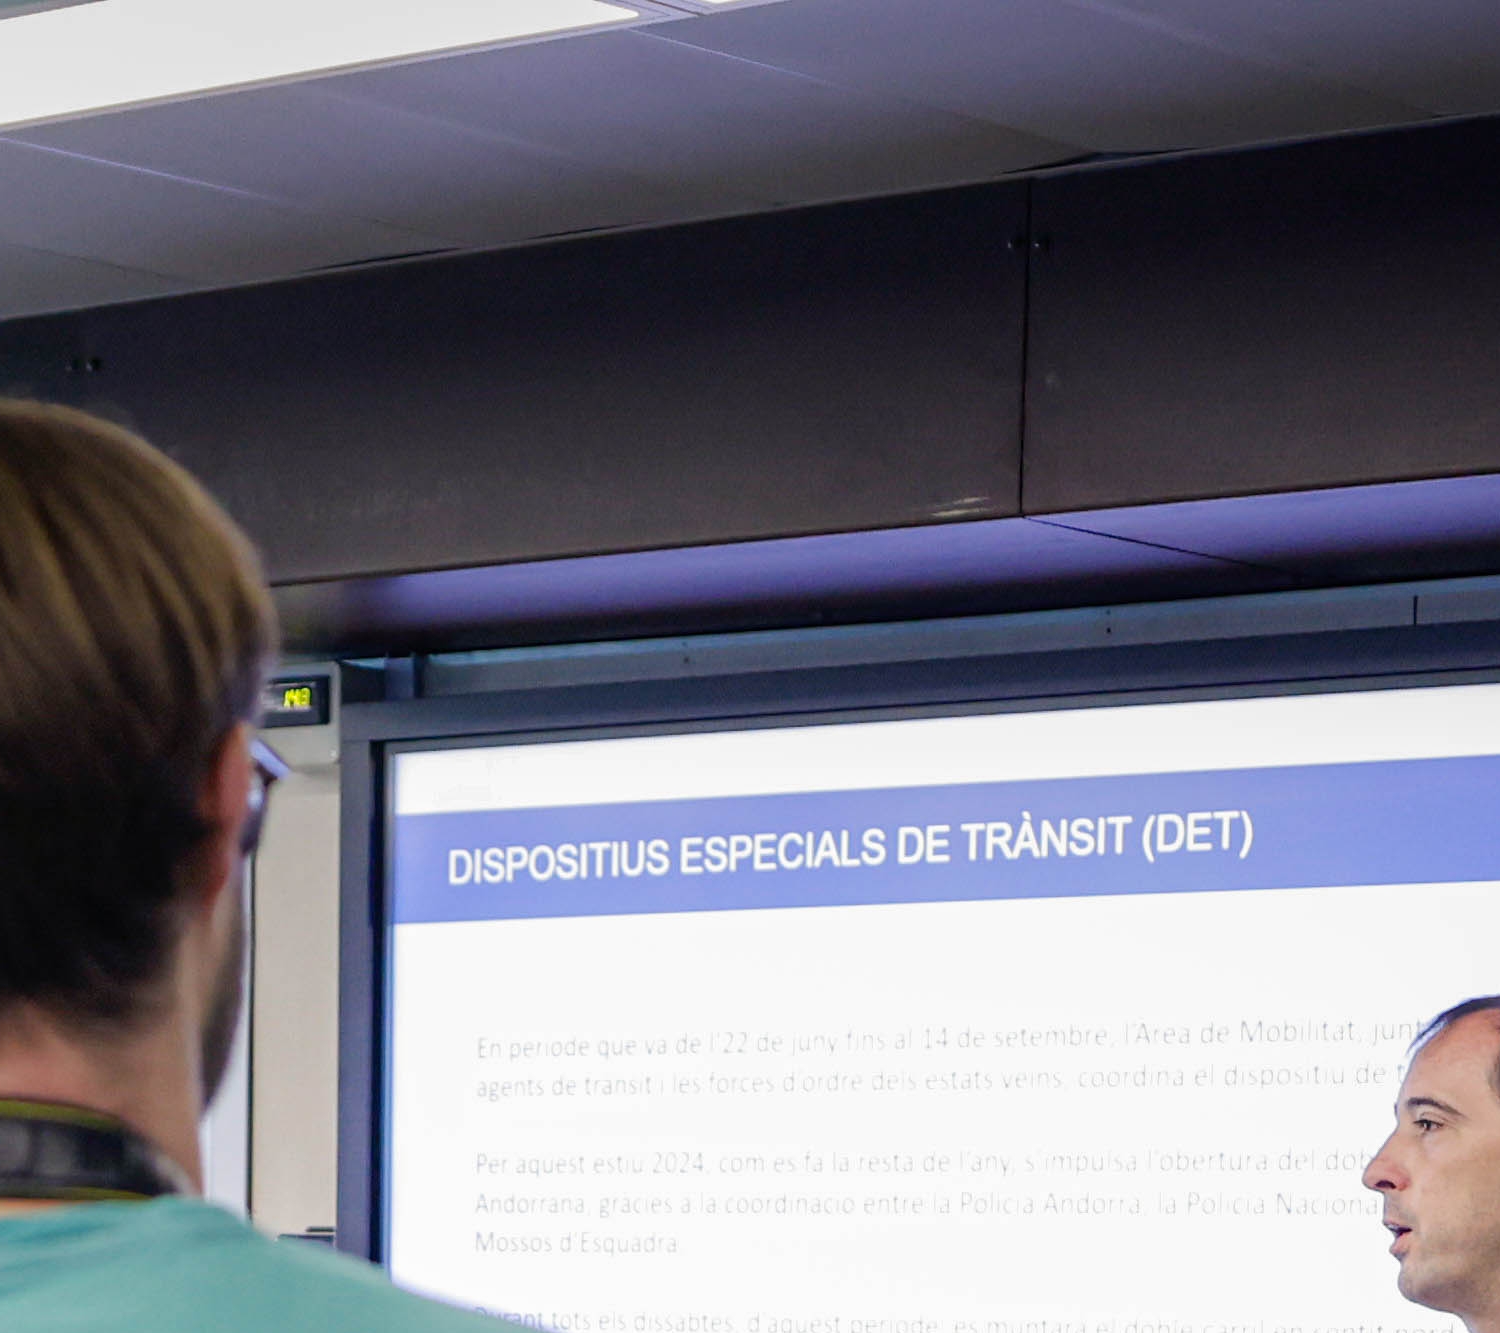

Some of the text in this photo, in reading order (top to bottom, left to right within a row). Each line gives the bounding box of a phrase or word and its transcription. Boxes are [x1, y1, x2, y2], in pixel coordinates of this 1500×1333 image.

[448, 810, 1254, 885] DISPOSITIUS ESPECIALS DE TRÀNSIT (DET)
[476, 1034, 502, 1058] En
[598, 1039, 637, 1061] que
[643, 1038, 668, 1055] va
[675, 1030, 701, 1054] de
[756, 1028, 784, 1053] de
[790, 1027, 838, 1058] juny
[924, 1025, 949, 1050] 14
[957, 1024, 986, 1049] de
[1199, 1019, 1230, 1045] de
[476, 1076, 544, 1103] agents
[551, 1073, 577, 1097] de
[673, 1071, 701, 1095] les
[708, 1069, 776, 1094] forces
[925, 1069, 995, 1091] estats
[1078, 1062, 1185, 1089] coordina
[1194, 1062, 1215, 1087] el
[1223, 1059, 1346, 1093] dispositiu
[1355, 1059, 1387, 1085] de
[476, 1151, 509, 1175] Per
[515, 1153, 585, 1180] aquest
[593, 1150, 644, 1174] estiu
[719, 1157, 765, 1174] com
[773, 1157, 797, 1173] es
[804, 1149, 823, 1173] fa
[832, 1149, 849, 1173] la
[859, 1152, 914, 1173] resta
[922, 1148, 951, 1173] de
[1277, 1146, 1315, 1172] del
[679, 1199, 692, 1215] a
[700, 1191, 717, 1215] la
[863, 1194, 928, 1215] entre
[935, 1191, 952, 1215] la
[1158, 1191, 1177, 1216] la
[1275, 1190, 1379, 1216] Naciona
[475, 1229, 553, 1253] Mossos
[551, 1309, 591, 1331] tots
[598, 1307, 627, 1331] els
